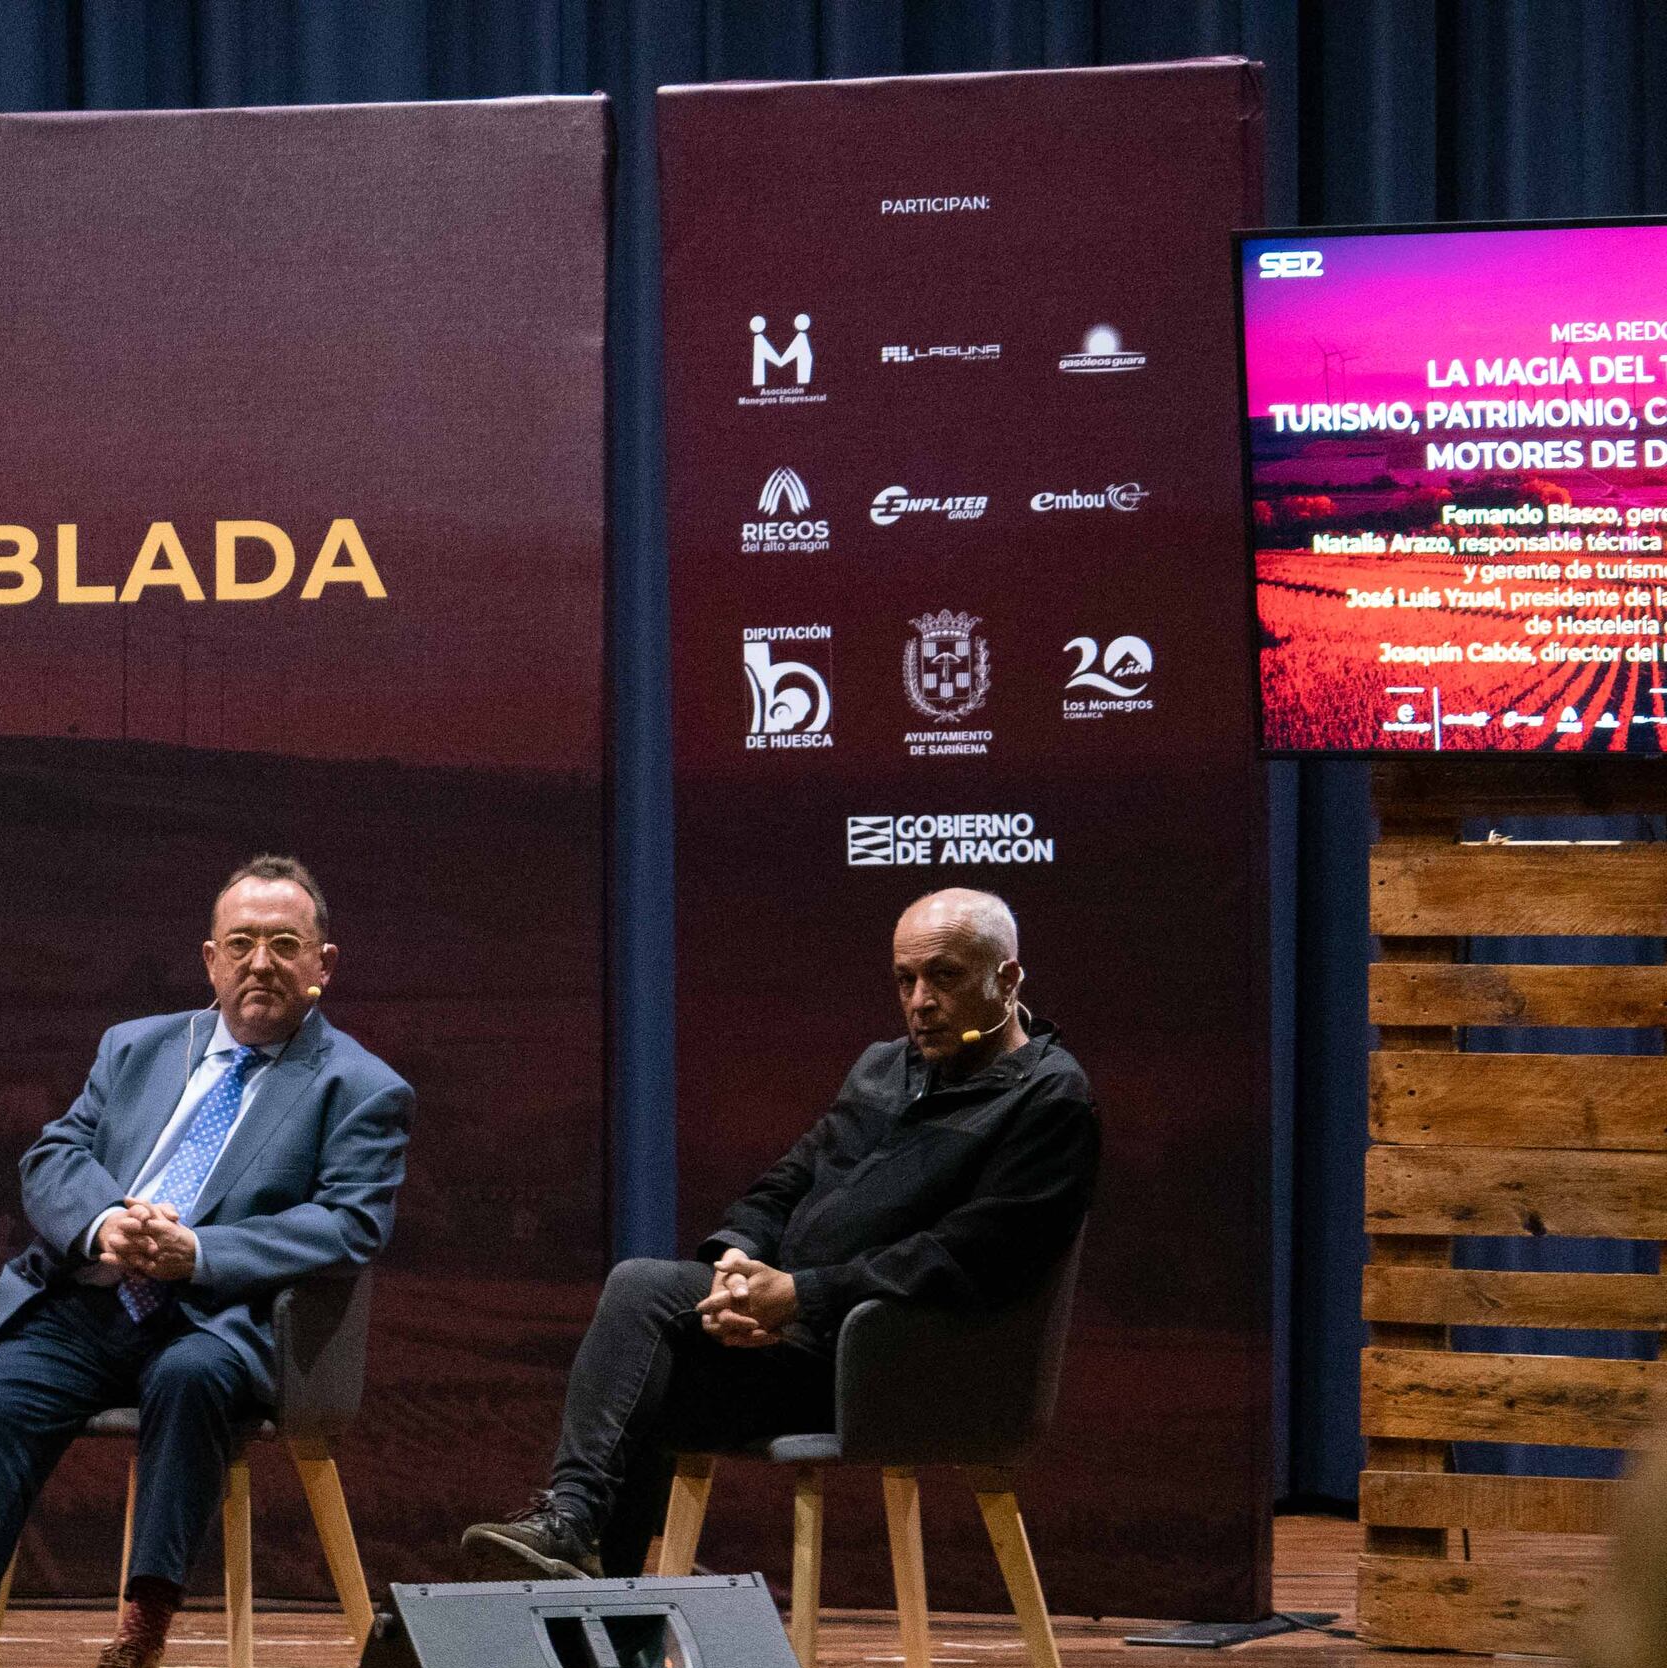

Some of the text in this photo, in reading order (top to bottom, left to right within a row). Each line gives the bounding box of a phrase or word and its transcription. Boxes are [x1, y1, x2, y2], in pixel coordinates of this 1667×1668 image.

[881, 195, 990, 215] PARTICIPAN:
[1550, 322, 1613, 343] MESA
[914, 344, 1002, 358] LAGUNA
[1059, 356, 1146, 370] gasóleos guara
[1426, 358, 1470, 388] LA
[1475, 356, 1583, 387] MAGIA
[1589, 355, 1655, 385] DEL
[738, 394, 827, 406] Monegros Empresarial
[760, 387, 805, 396] Asociación
[1268, 401, 1421, 435] TURISMO,
[1425, 397, 1638, 431] PATRIMONIO,
[1426, 439, 1585, 471] MOTORES
[1590, 439, 1637, 469] DE
[1030, 488, 1105, 511] embou
[948, 509, 985, 520] GROUP
[1442, 503, 1544, 526] Fernando
[1547, 502, 1624, 527] Blasco,
[741, 520, 829, 541] RIEGOS
[741, 538, 830, 554] del alto aragón
[1313, 530, 1663, 557] Natalia Arazo, responsable técnica
[1463, 558, 1667, 585] y gerente de turism
[1346, 586, 1395, 609] José
[1397, 586, 1442, 608] Luis
[1443, 586, 1507, 610] Yzuel,
[1510, 586, 1621, 611] presidente
[1623, 586, 1652, 607] de
[743, 623, 831, 642] DIPUTACIÓN
[1524, 614, 1553, 635] de
[1556, 614, 1660, 635] Hostelería
[1378, 641, 1464, 667] Joaquín
[1466, 641, 1538, 665] Cabós,
[1540, 641, 1622, 663] director
[1625, 641, 1659, 663] del
[1063, 699, 1154, 713] Los Monegros
[1063, 711, 1105, 720] COMARCA
[746, 732, 834, 749] DE HUESCA
[904, 730, 993, 743] AYUNTAMIENTO
[910, 742, 988, 756] DE SARIÑENA
[895, 813, 1034, 840] GOBIERNO
[896, 838, 1053, 865] DE ARAGON
